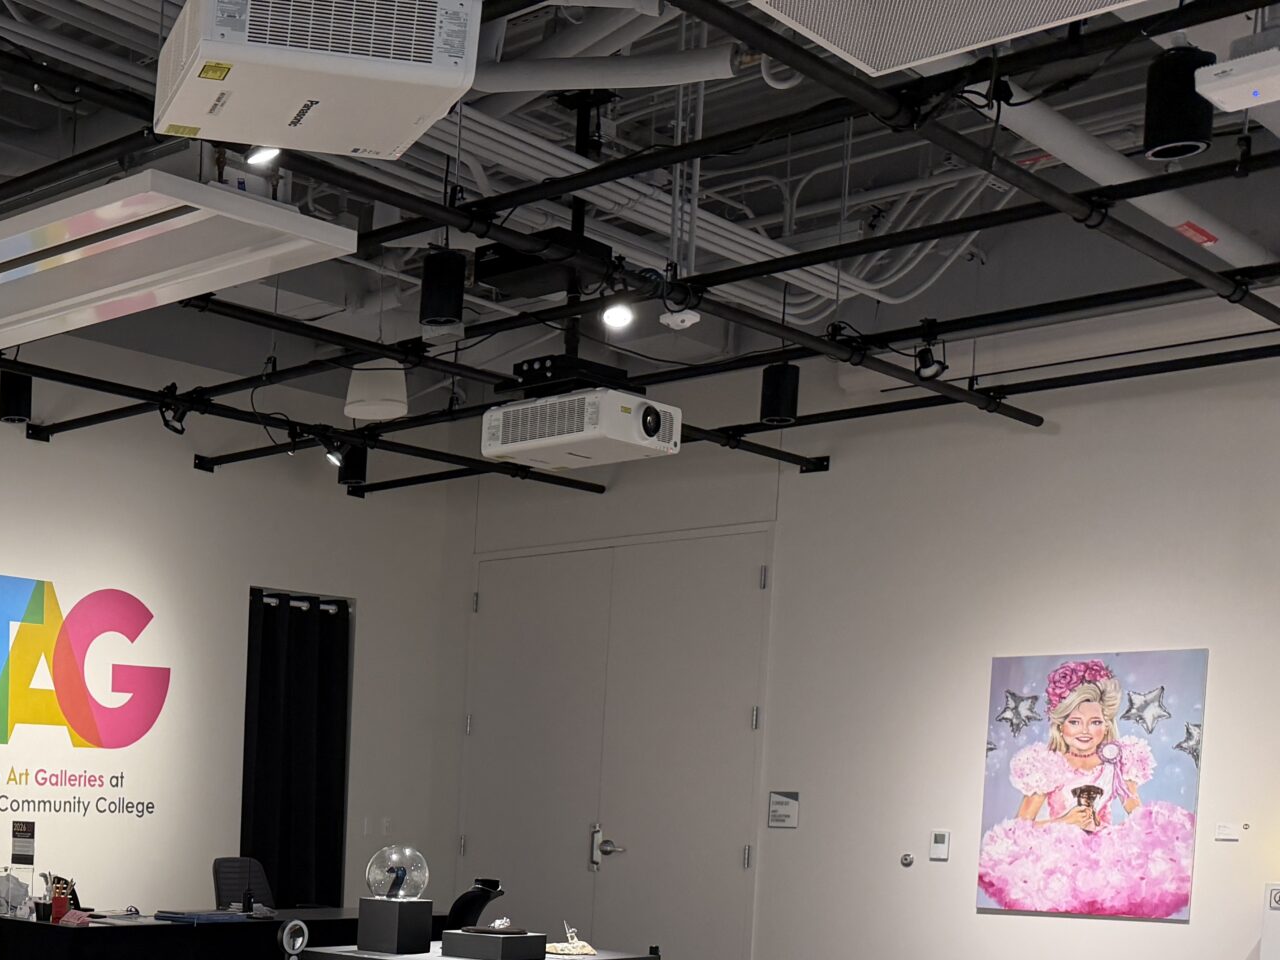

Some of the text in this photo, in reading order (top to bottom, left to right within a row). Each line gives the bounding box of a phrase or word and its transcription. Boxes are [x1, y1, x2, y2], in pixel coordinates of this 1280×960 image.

[288, 100, 319, 127] Panasonic
[6, 766, 29, 785] Art
[34, 769, 104, 788] Galleries
[109, 772, 124, 788] at
[95, 796, 155, 818] College
